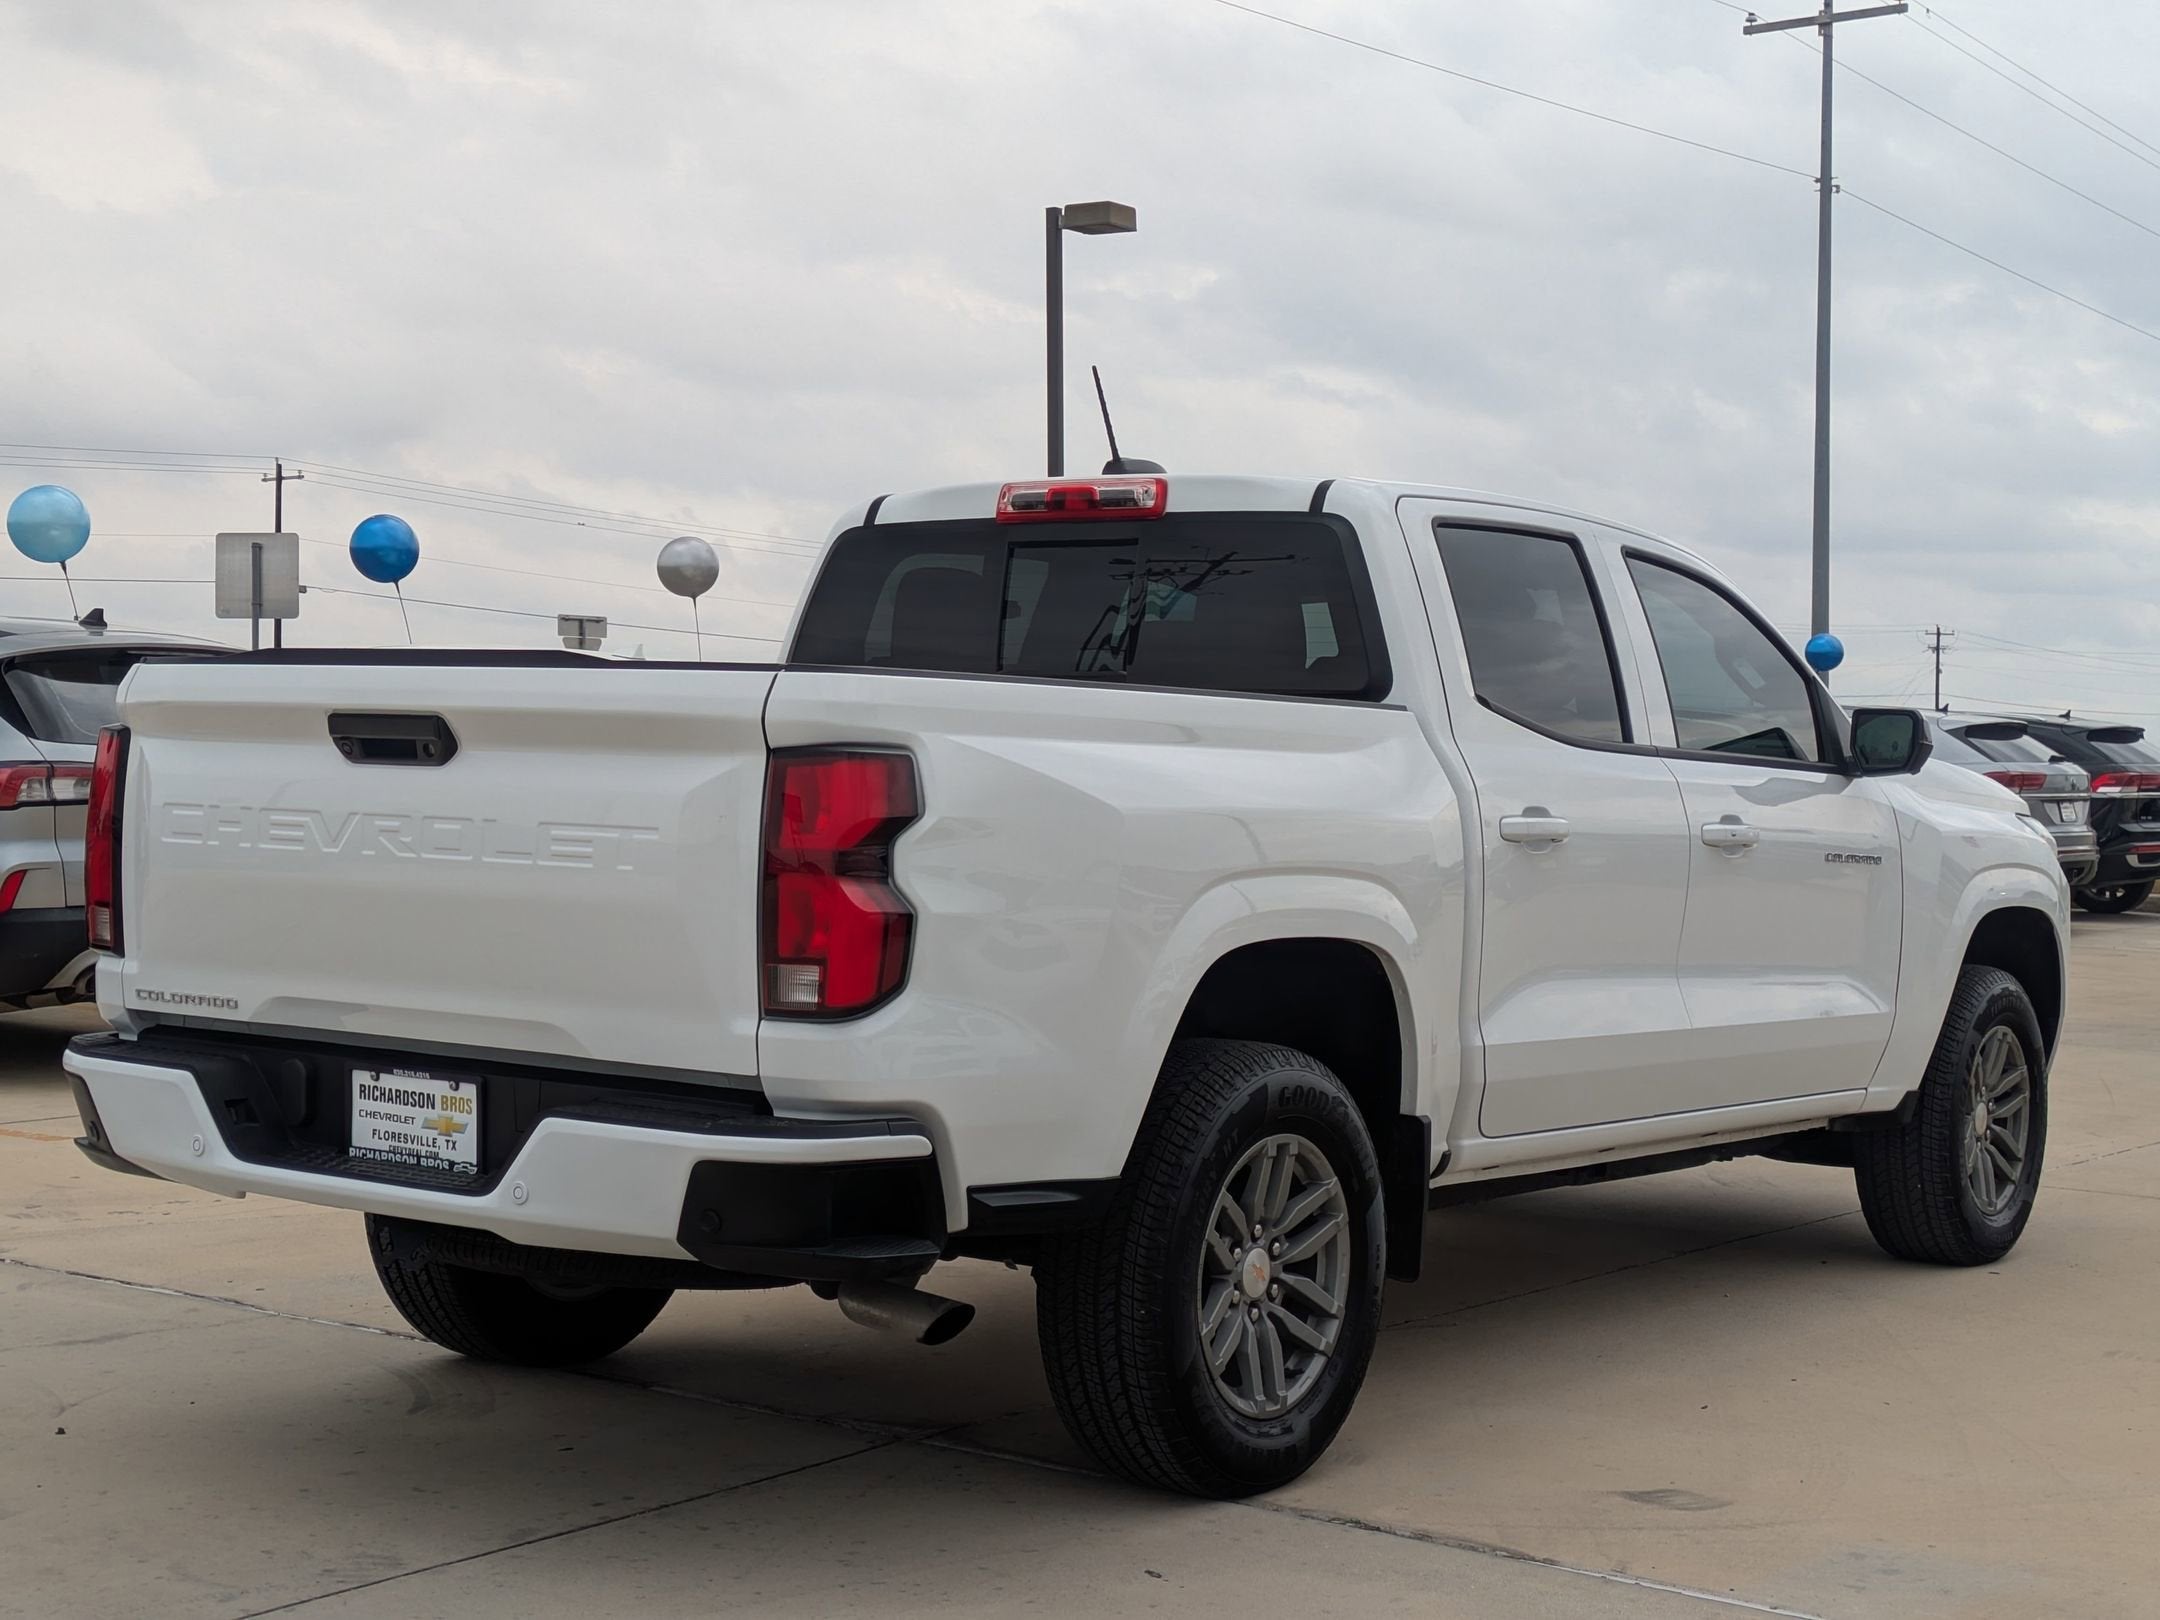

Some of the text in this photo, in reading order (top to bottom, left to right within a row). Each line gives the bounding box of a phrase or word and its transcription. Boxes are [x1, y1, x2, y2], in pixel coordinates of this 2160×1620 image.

[161, 802, 660, 871] CHEVROLET
[135, 988, 239, 1010] COLORADO
[359, 1083, 473, 1115] RICHARDSON BROS
[358, 1109, 416, 1125] CHEVROLET
[371, 1128, 457, 1151] FLORESVILLE, TX
